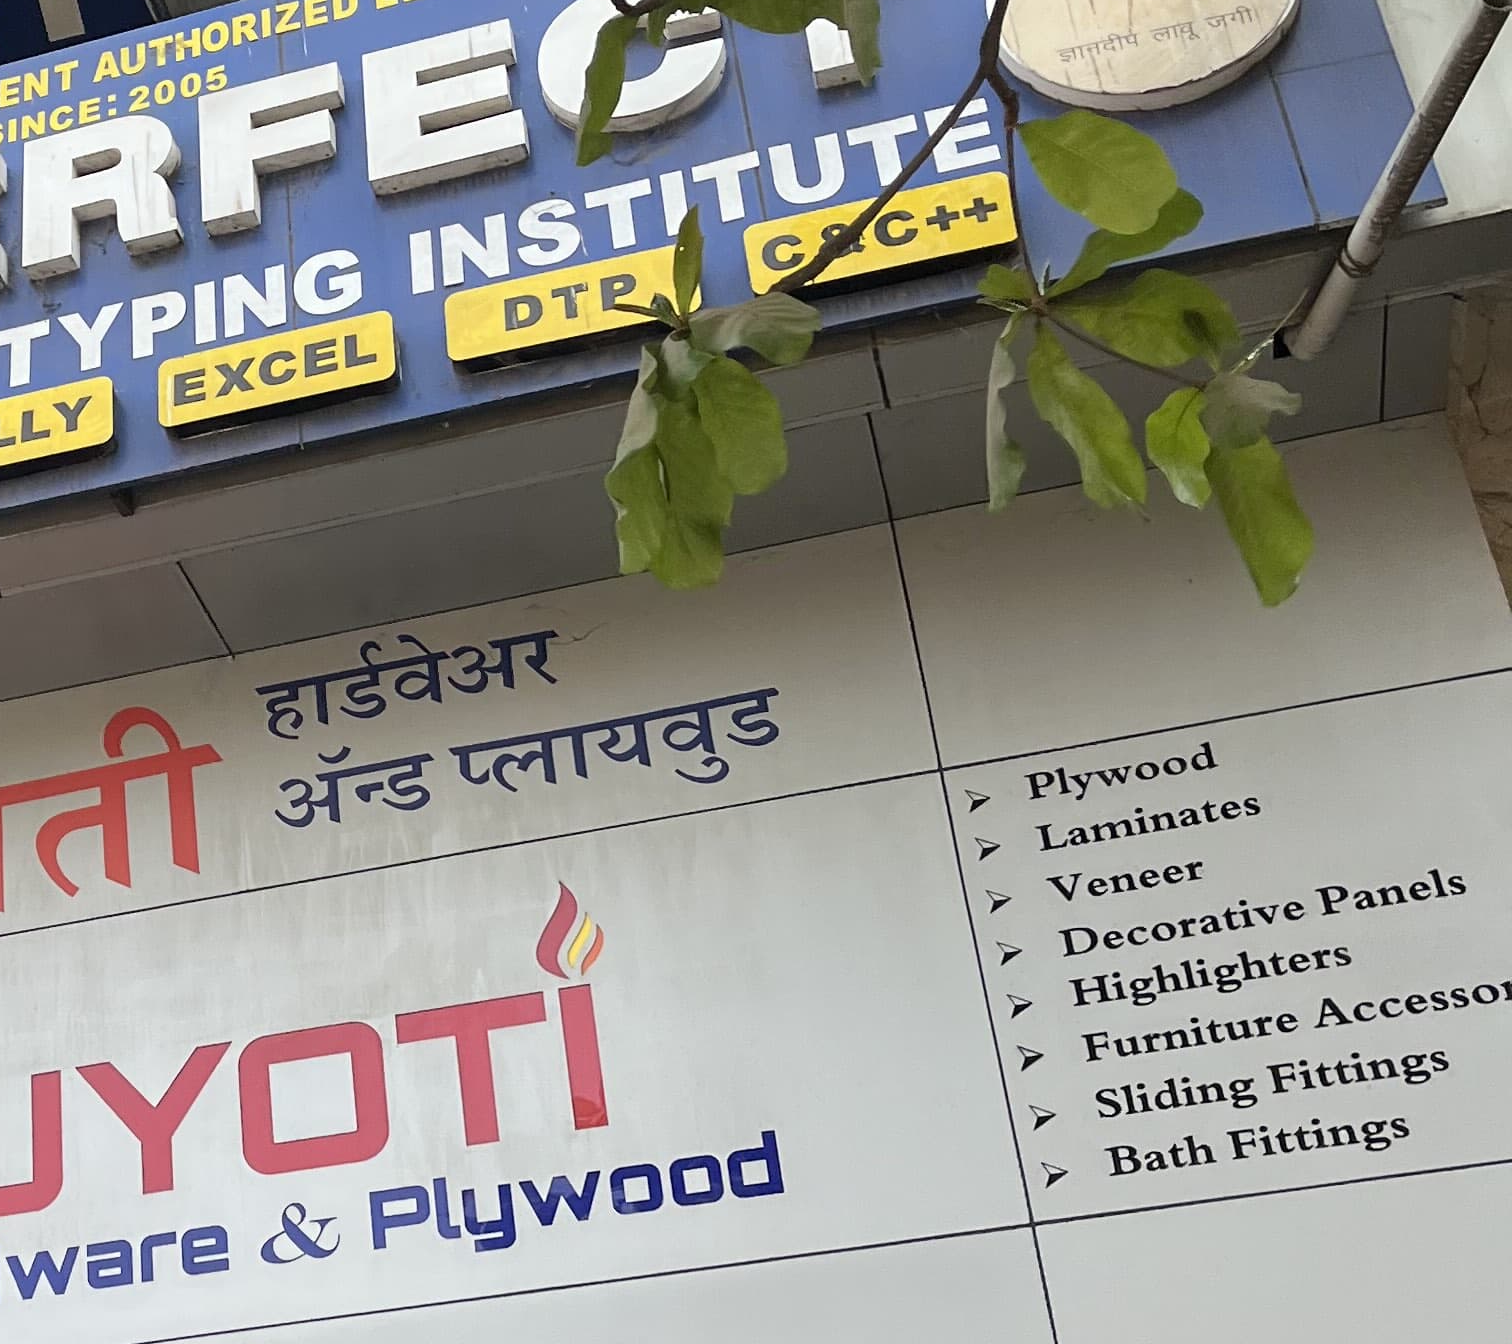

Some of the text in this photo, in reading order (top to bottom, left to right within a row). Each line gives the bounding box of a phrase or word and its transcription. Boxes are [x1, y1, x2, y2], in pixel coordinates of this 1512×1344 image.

[408, 96, 1002, 296] INSTITUTE
[172, 333, 379, 408] EXCEL
[503, 272, 639, 333] DTP
[256, 629, 560, 740] हार्डवेअर
[450, 687, 780, 793] प्लायवुड
[1024, 741, 1219, 802] Plywood
[1034, 794, 1262, 853] Laminates
[1046, 858, 1206, 904] Veneer
[1058, 868, 1468, 958] Decorative Panels
[1068, 942, 1354, 1007] Highlighters
[1081, 1011, 1299, 1063] Furniture
[1094, 1044, 1451, 1120] Sliding Fittings
[1104, 1112, 1412, 1178] Bath Fittings
[259, 1201, 341, 1265] &
[369, 1129, 785, 1254] Plywood
